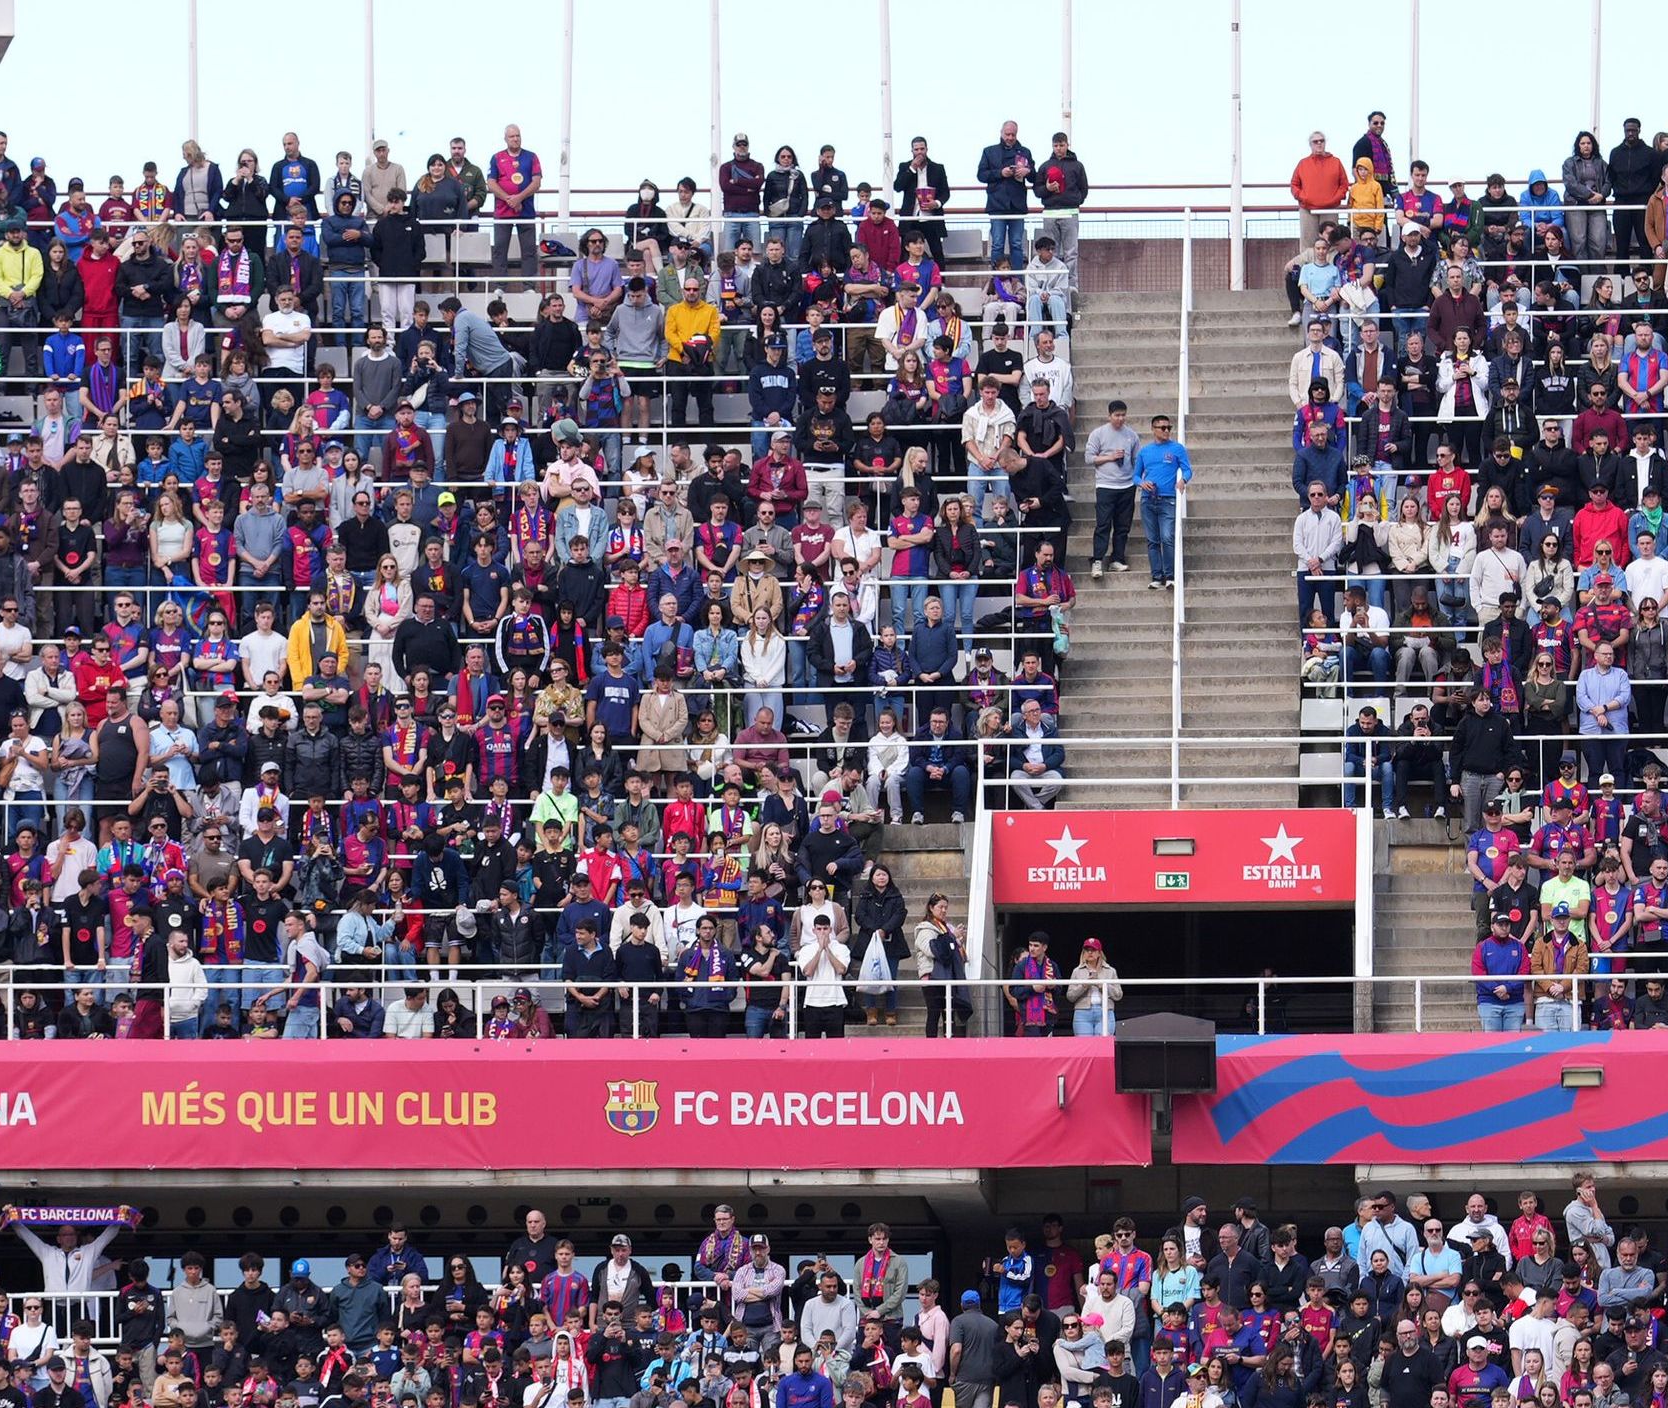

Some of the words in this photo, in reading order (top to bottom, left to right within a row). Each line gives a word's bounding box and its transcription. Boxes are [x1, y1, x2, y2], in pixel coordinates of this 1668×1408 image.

[1452, 530, 1460, 544] 4
[1027, 866, 1107, 882] ESTRELLA
[1243, 864, 1322, 881] ESTRELLA
[1053, 882, 1081, 890] DAMM
[1268, 880, 1297, 889] DAMM
[141, 1080, 226, 1125] MÉS
[236, 1091, 317, 1132] QUE
[328, 1091, 384, 1125] UN
[395, 1091, 497, 1125] CLUB
[674, 1090, 719, 1125] FC
[730, 1091, 964, 1125] BARCELONA
[20, 1208, 39, 1222] FC
[43, 1207, 115, 1222] BARCELONA
